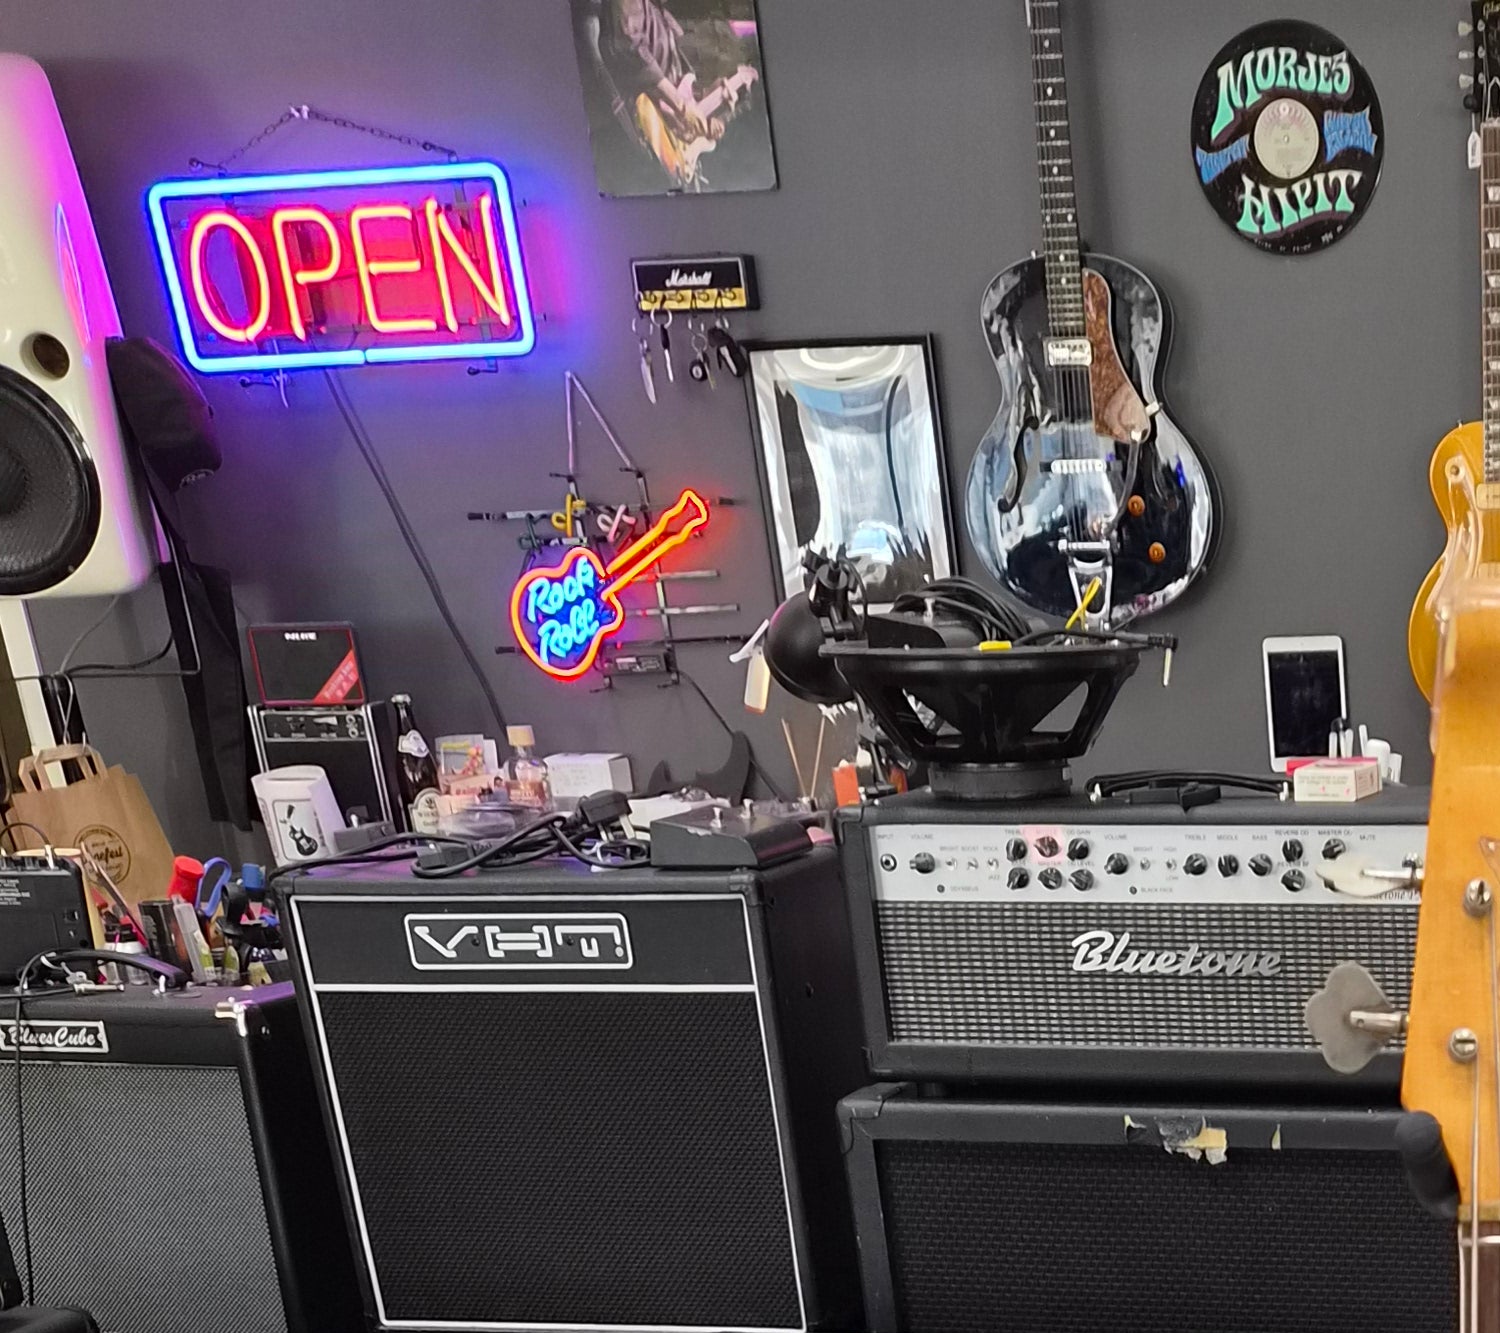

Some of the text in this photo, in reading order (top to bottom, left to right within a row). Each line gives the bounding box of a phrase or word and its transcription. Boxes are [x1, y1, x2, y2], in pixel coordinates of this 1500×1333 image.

[1211, 46, 1351, 145] MORJES
[1236, 168, 1363, 234] HIPIT
[189, 194, 512, 343] OPEN
[665, 267, 713, 287] Marshall
[527, 555, 595, 624] Rock
[537, 598, 600, 665] Roll
[414, 925, 624, 958] VHT
[1072, 930, 1282, 977] Bluetone
